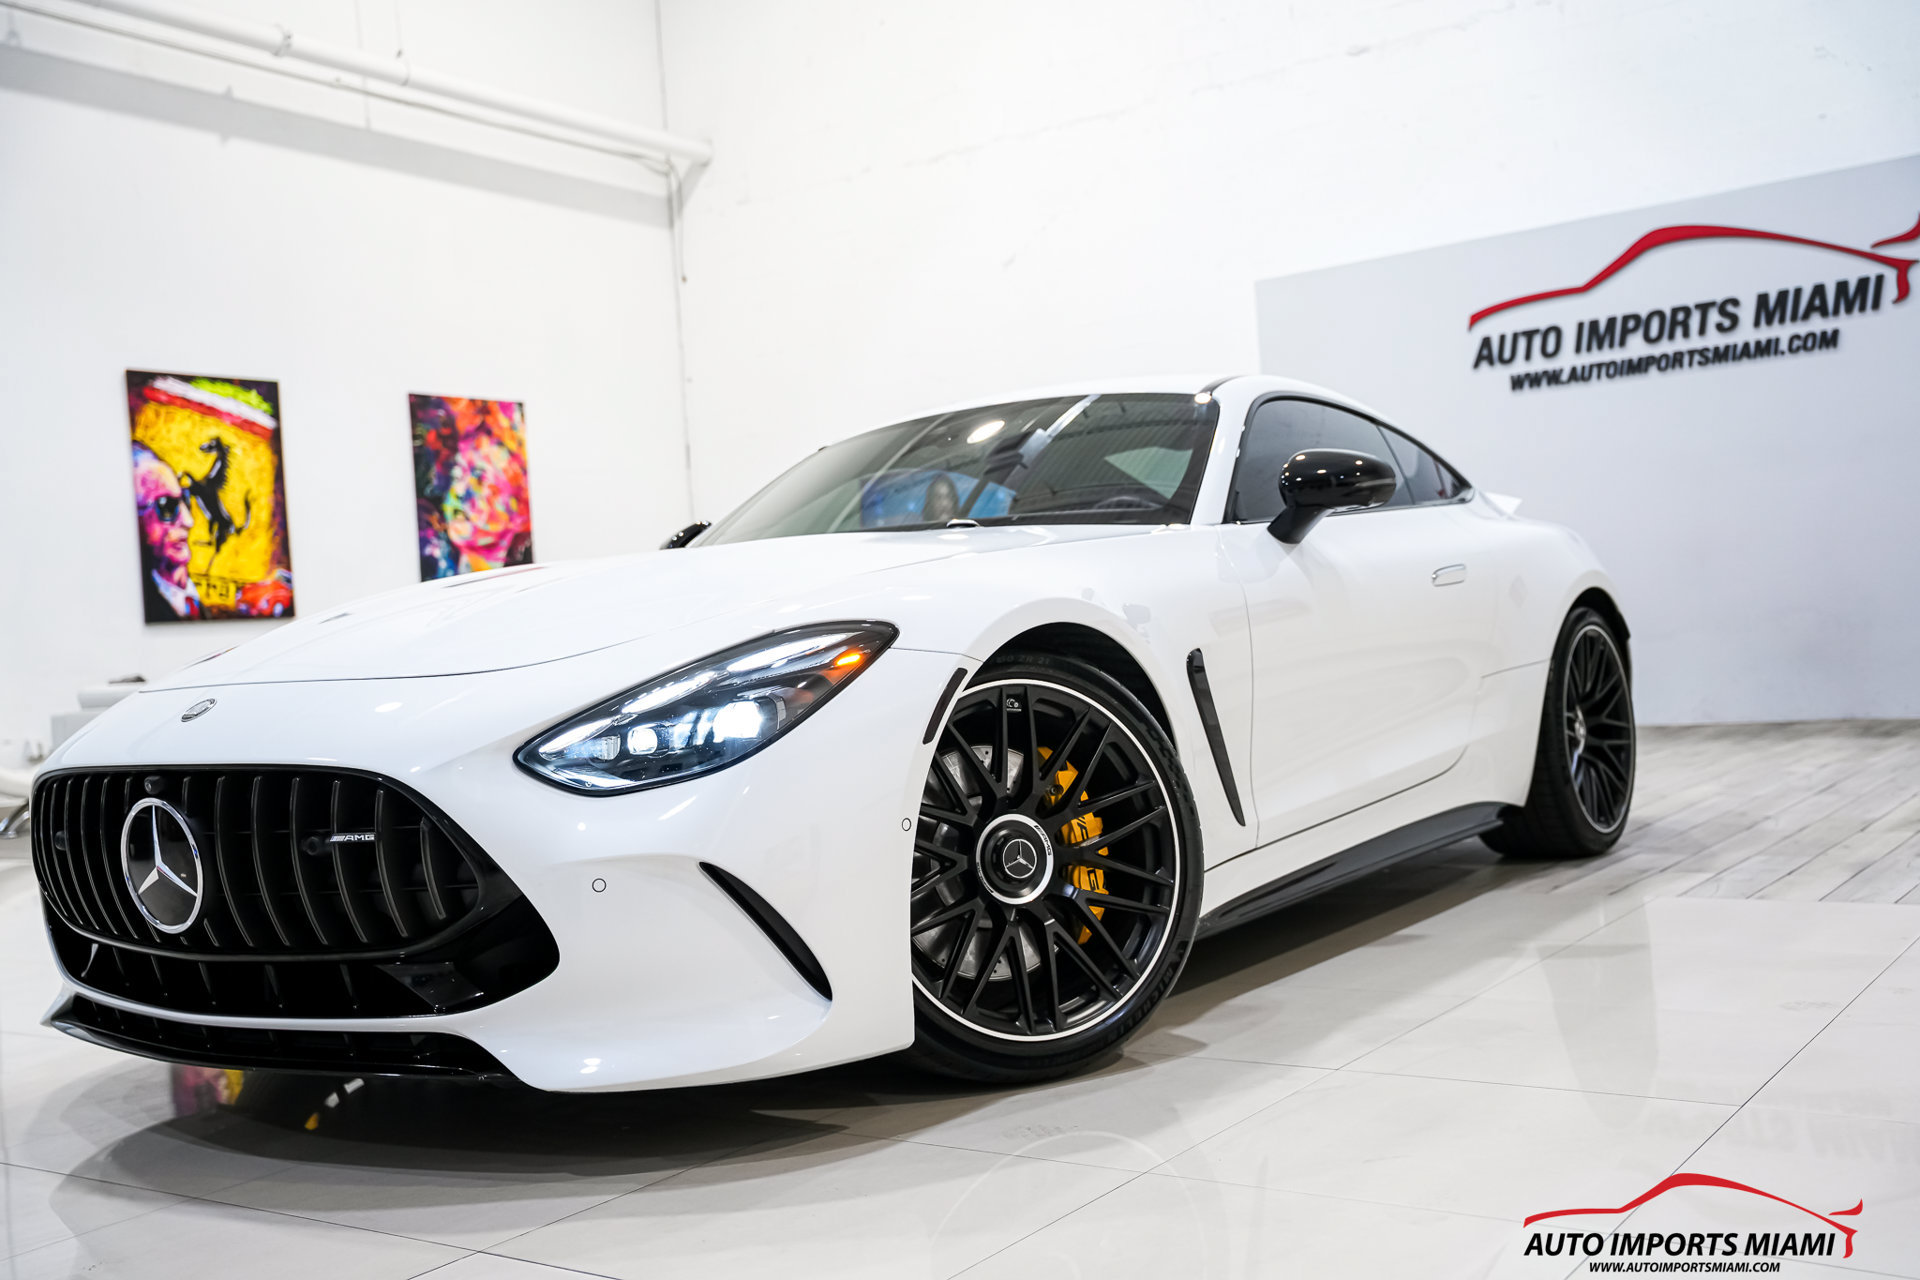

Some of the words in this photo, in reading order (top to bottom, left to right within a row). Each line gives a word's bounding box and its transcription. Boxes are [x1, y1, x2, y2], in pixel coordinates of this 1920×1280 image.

[1473, 325, 1563, 370] AUTO
[1574, 297, 1741, 355] IMPORTS
[1753, 273, 1885, 329] MIAMI
[1510, 328, 1840, 391] WWW.AUTOIMPORTSMIAMI.COM
